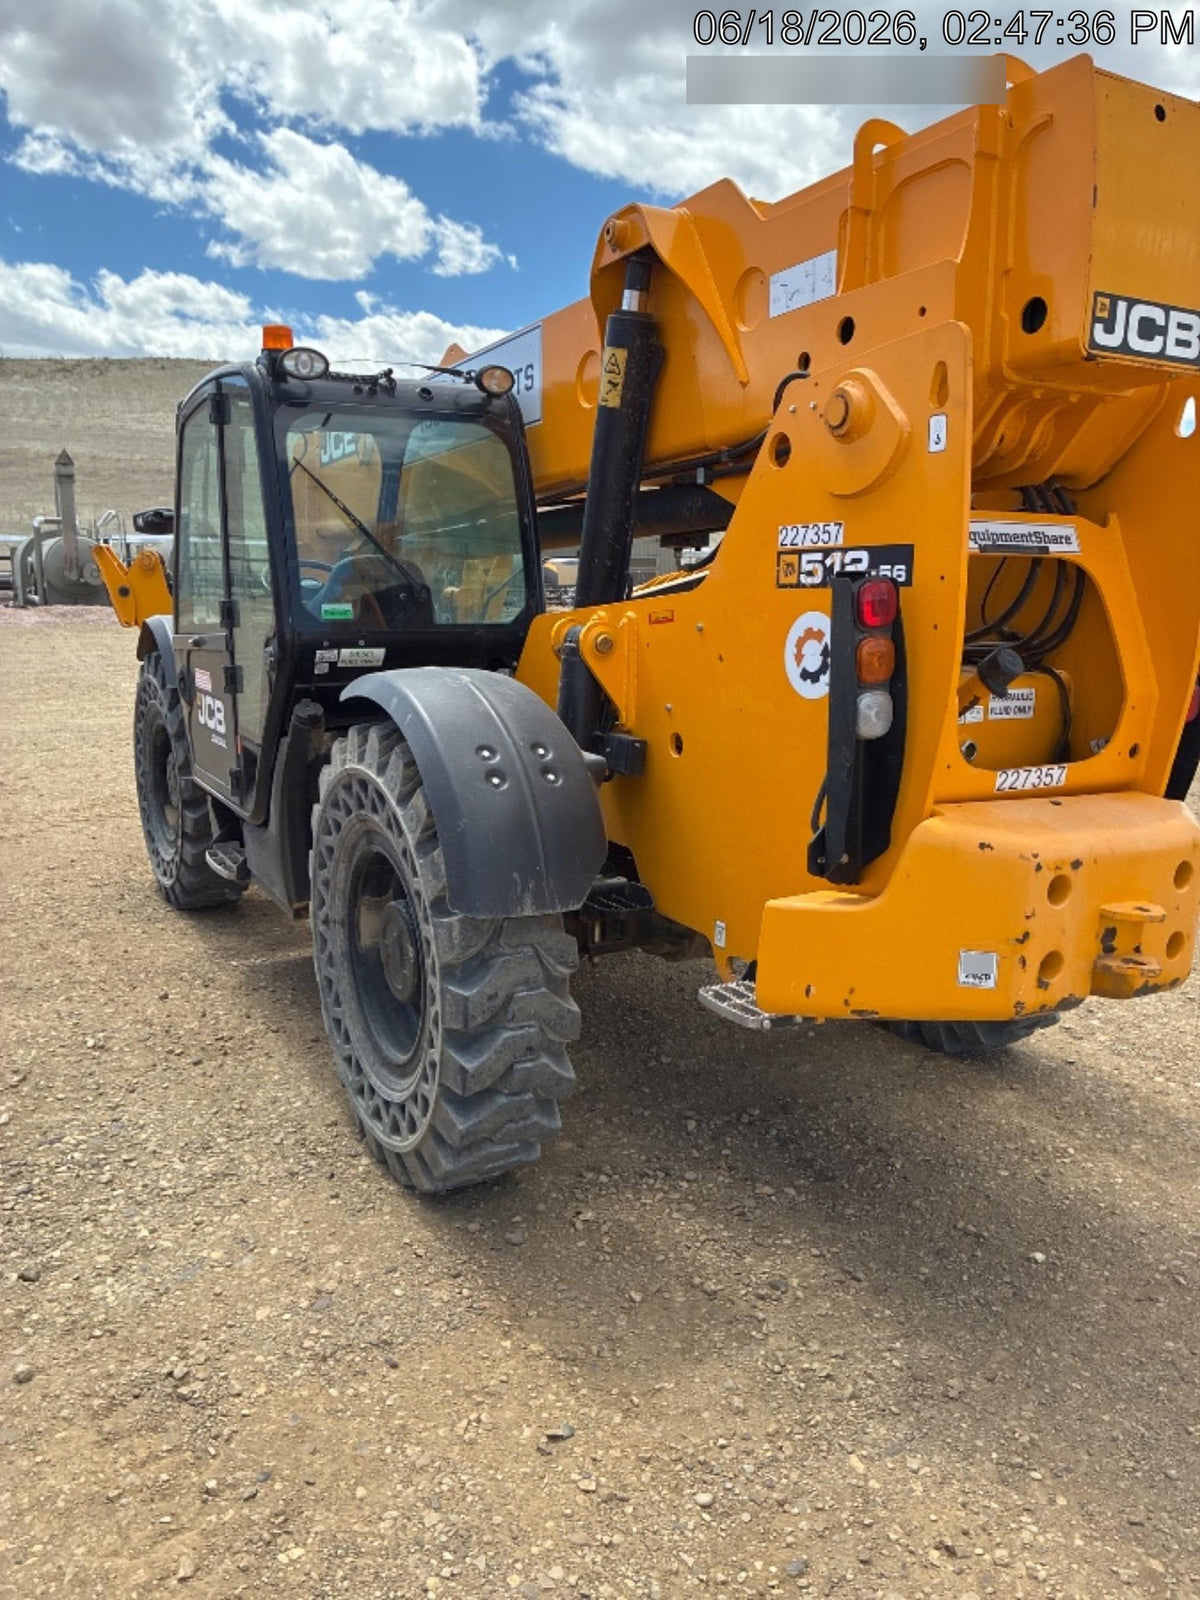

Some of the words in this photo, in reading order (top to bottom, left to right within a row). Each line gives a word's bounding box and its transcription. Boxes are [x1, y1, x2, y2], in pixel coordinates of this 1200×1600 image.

[1093, 300, 1200, 359] JCB
[780, 522, 843, 547] 227357
[968, 529, 1073, 545] quipmentShare
[198, 692, 227, 735] JCB
[996, 765, 1067, 792] 227357
